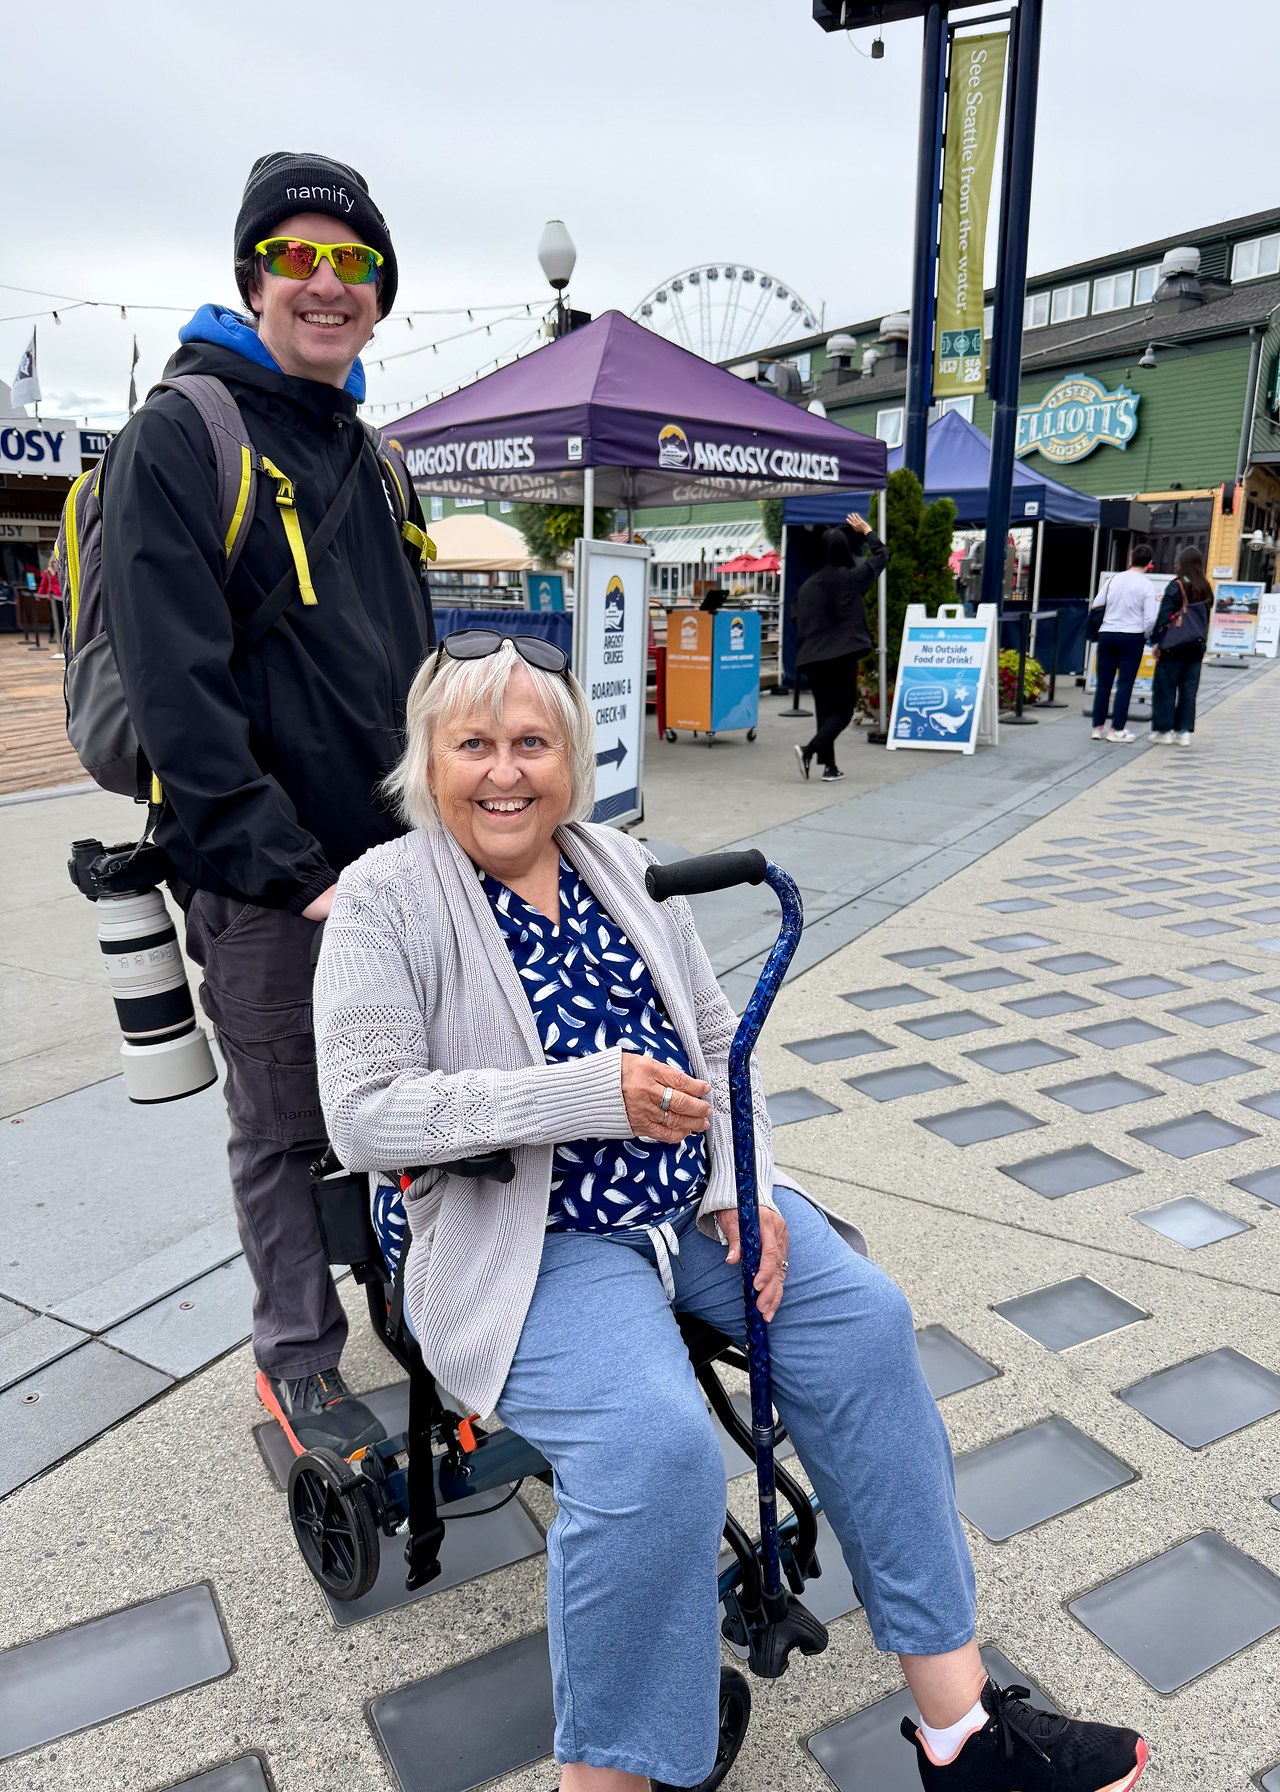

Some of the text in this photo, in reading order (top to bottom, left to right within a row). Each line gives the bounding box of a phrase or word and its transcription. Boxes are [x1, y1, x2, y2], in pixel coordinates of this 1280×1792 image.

[956, 49, 987, 315] See Seattle from the water.
[286, 184, 354, 213] namify
[964, 367, 981, 383] 26
[1048, 385, 1096, 409] OYSTER
[0, 428, 65, 462] OSY
[86, 435, 108, 451] TIL
[406, 436, 536, 476] ARGOSY CRUISES
[693, 441, 840, 482] ARGOSY CRUISES
[603, 635, 624, 649] ARGOSY
[922, 645, 967, 653] No Outside
[603, 650, 624, 665] CRUISES
[914, 655, 933, 664] Food
[946, 655, 973, 664] Drink!
[592, 678, 632, 700] BOARDING &
[596, 704, 627, 725] CHECK-IN
[280, 1105, 321, 1120] nami
